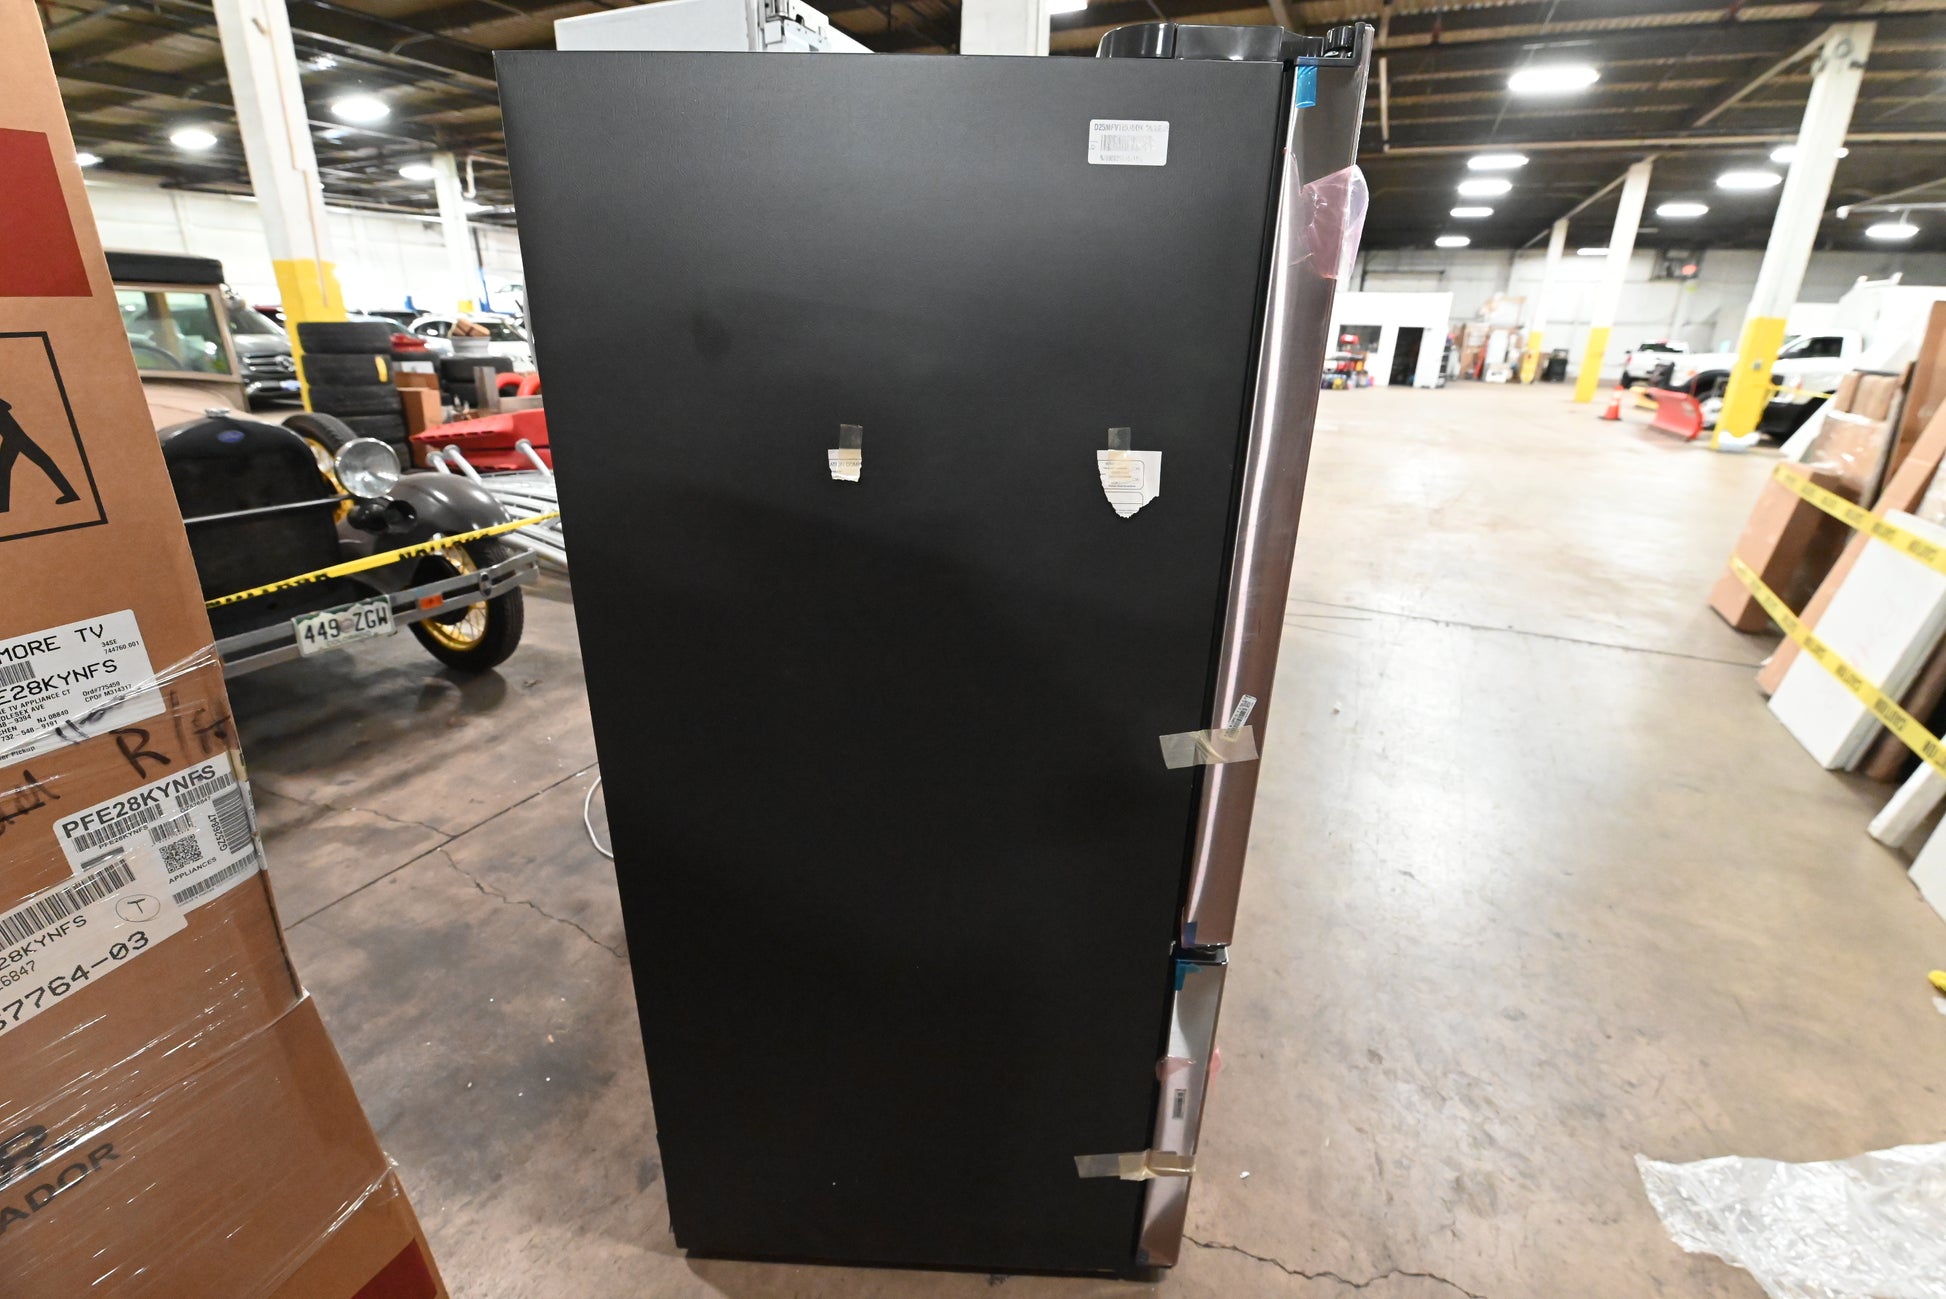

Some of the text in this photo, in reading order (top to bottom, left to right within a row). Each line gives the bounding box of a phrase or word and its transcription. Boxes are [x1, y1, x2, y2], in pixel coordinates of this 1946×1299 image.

[74, 624, 104, 642] TV
[304, 618, 341, 644] 449
[352, 606, 389, 632] ZGW
[20, 692, 60, 708] APPLIANCE
[31, 704, 45, 712] AVE
[11, 745, 36, 757] Pickup
[62, 764, 216, 839] PFE28KYNFS
[168, 856, 217, 885] APPLIANCES
[127, 897, 147, 915] T
[0, 959, 36, 991] 6847
[0, 1142, 120, 1236] ADOR
